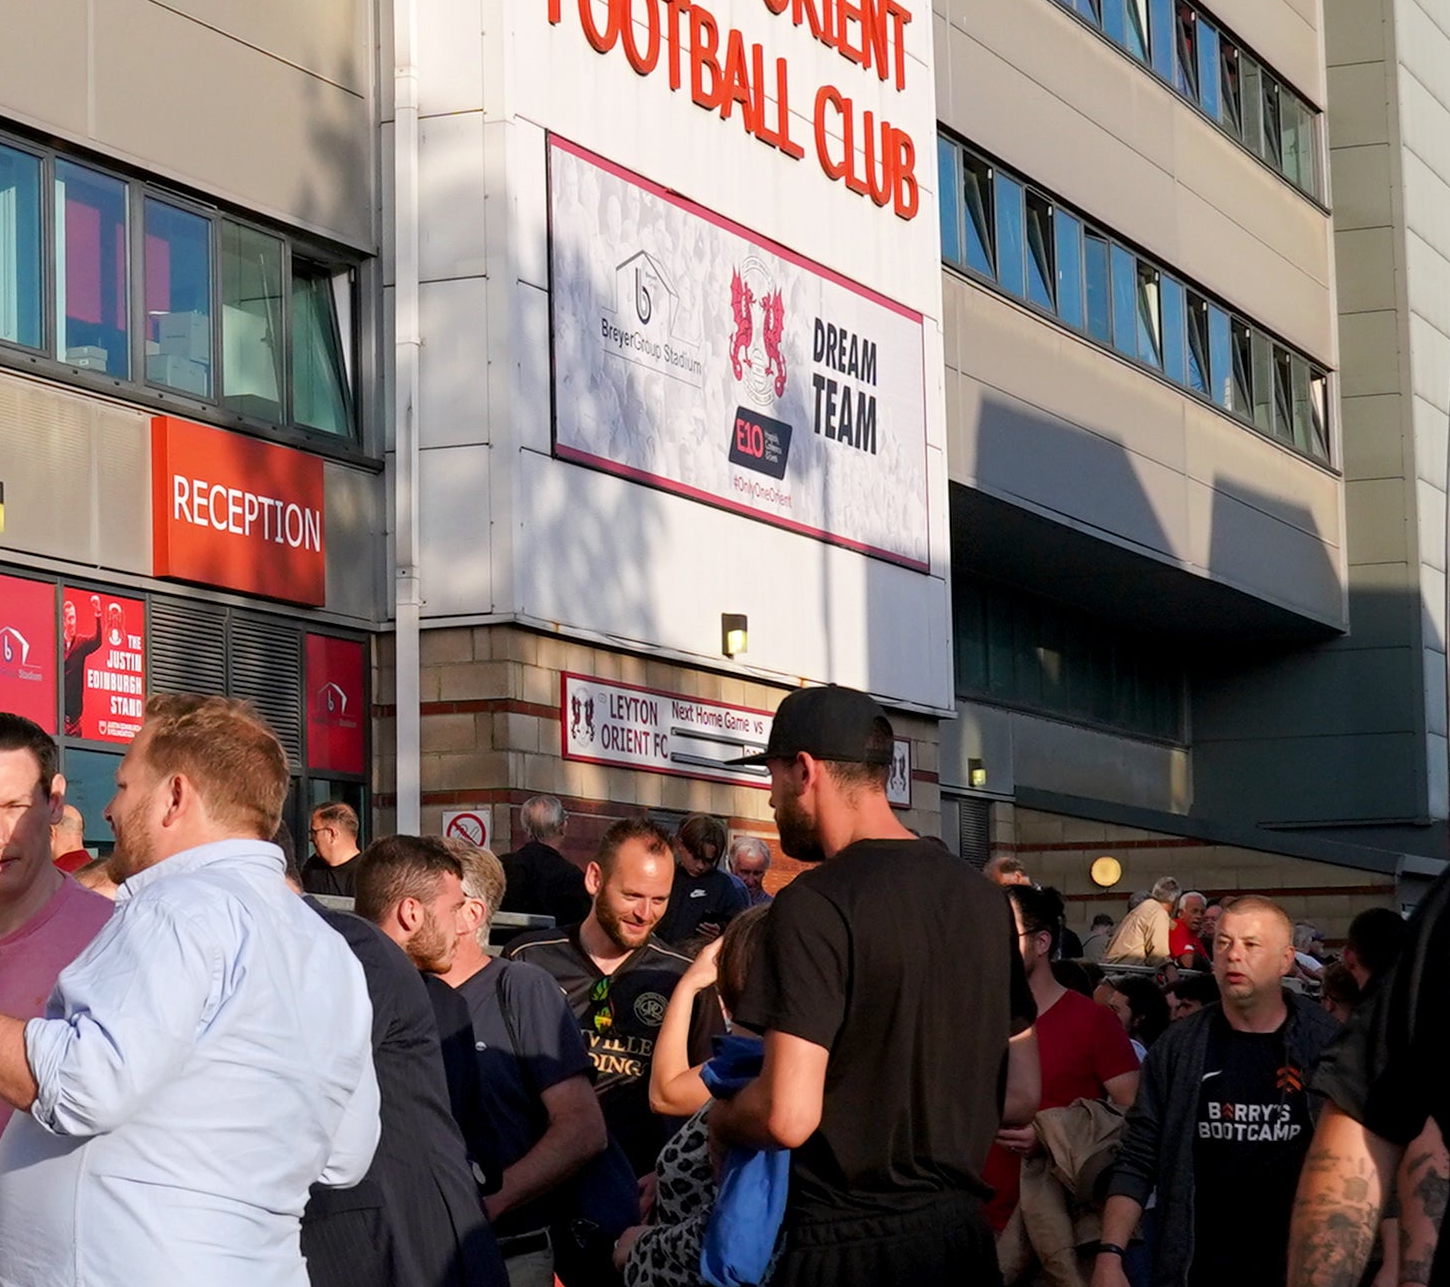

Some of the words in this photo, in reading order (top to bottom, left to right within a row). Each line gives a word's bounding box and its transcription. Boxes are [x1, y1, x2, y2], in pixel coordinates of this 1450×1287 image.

[814, 85, 919, 221] CLUB
[663, 343, 702, 376] Stadium
[813, 317, 877, 387] DREAM
[813, 372, 877, 456] TEAM
[736, 418, 765, 459] E10
[173, 474, 321, 553] RECEPTION
[128, 635, 141, 650] THE
[107, 650, 142, 672] JUSTIN
[87, 669, 142, 694] EDINBURGH
[110, 696, 142, 717] STAND
[610, 693, 658, 726] LEYTON
[672, 701, 694, 722] Next
[695, 706, 722, 728] Home
[724, 712, 749, 732] Game
[753, 721, 763, 734] vs
[601, 724, 650, 756] ORIENT
[654, 733, 668, 759] FC
[1198, 1121, 1302, 1142] BOOTCAMP
